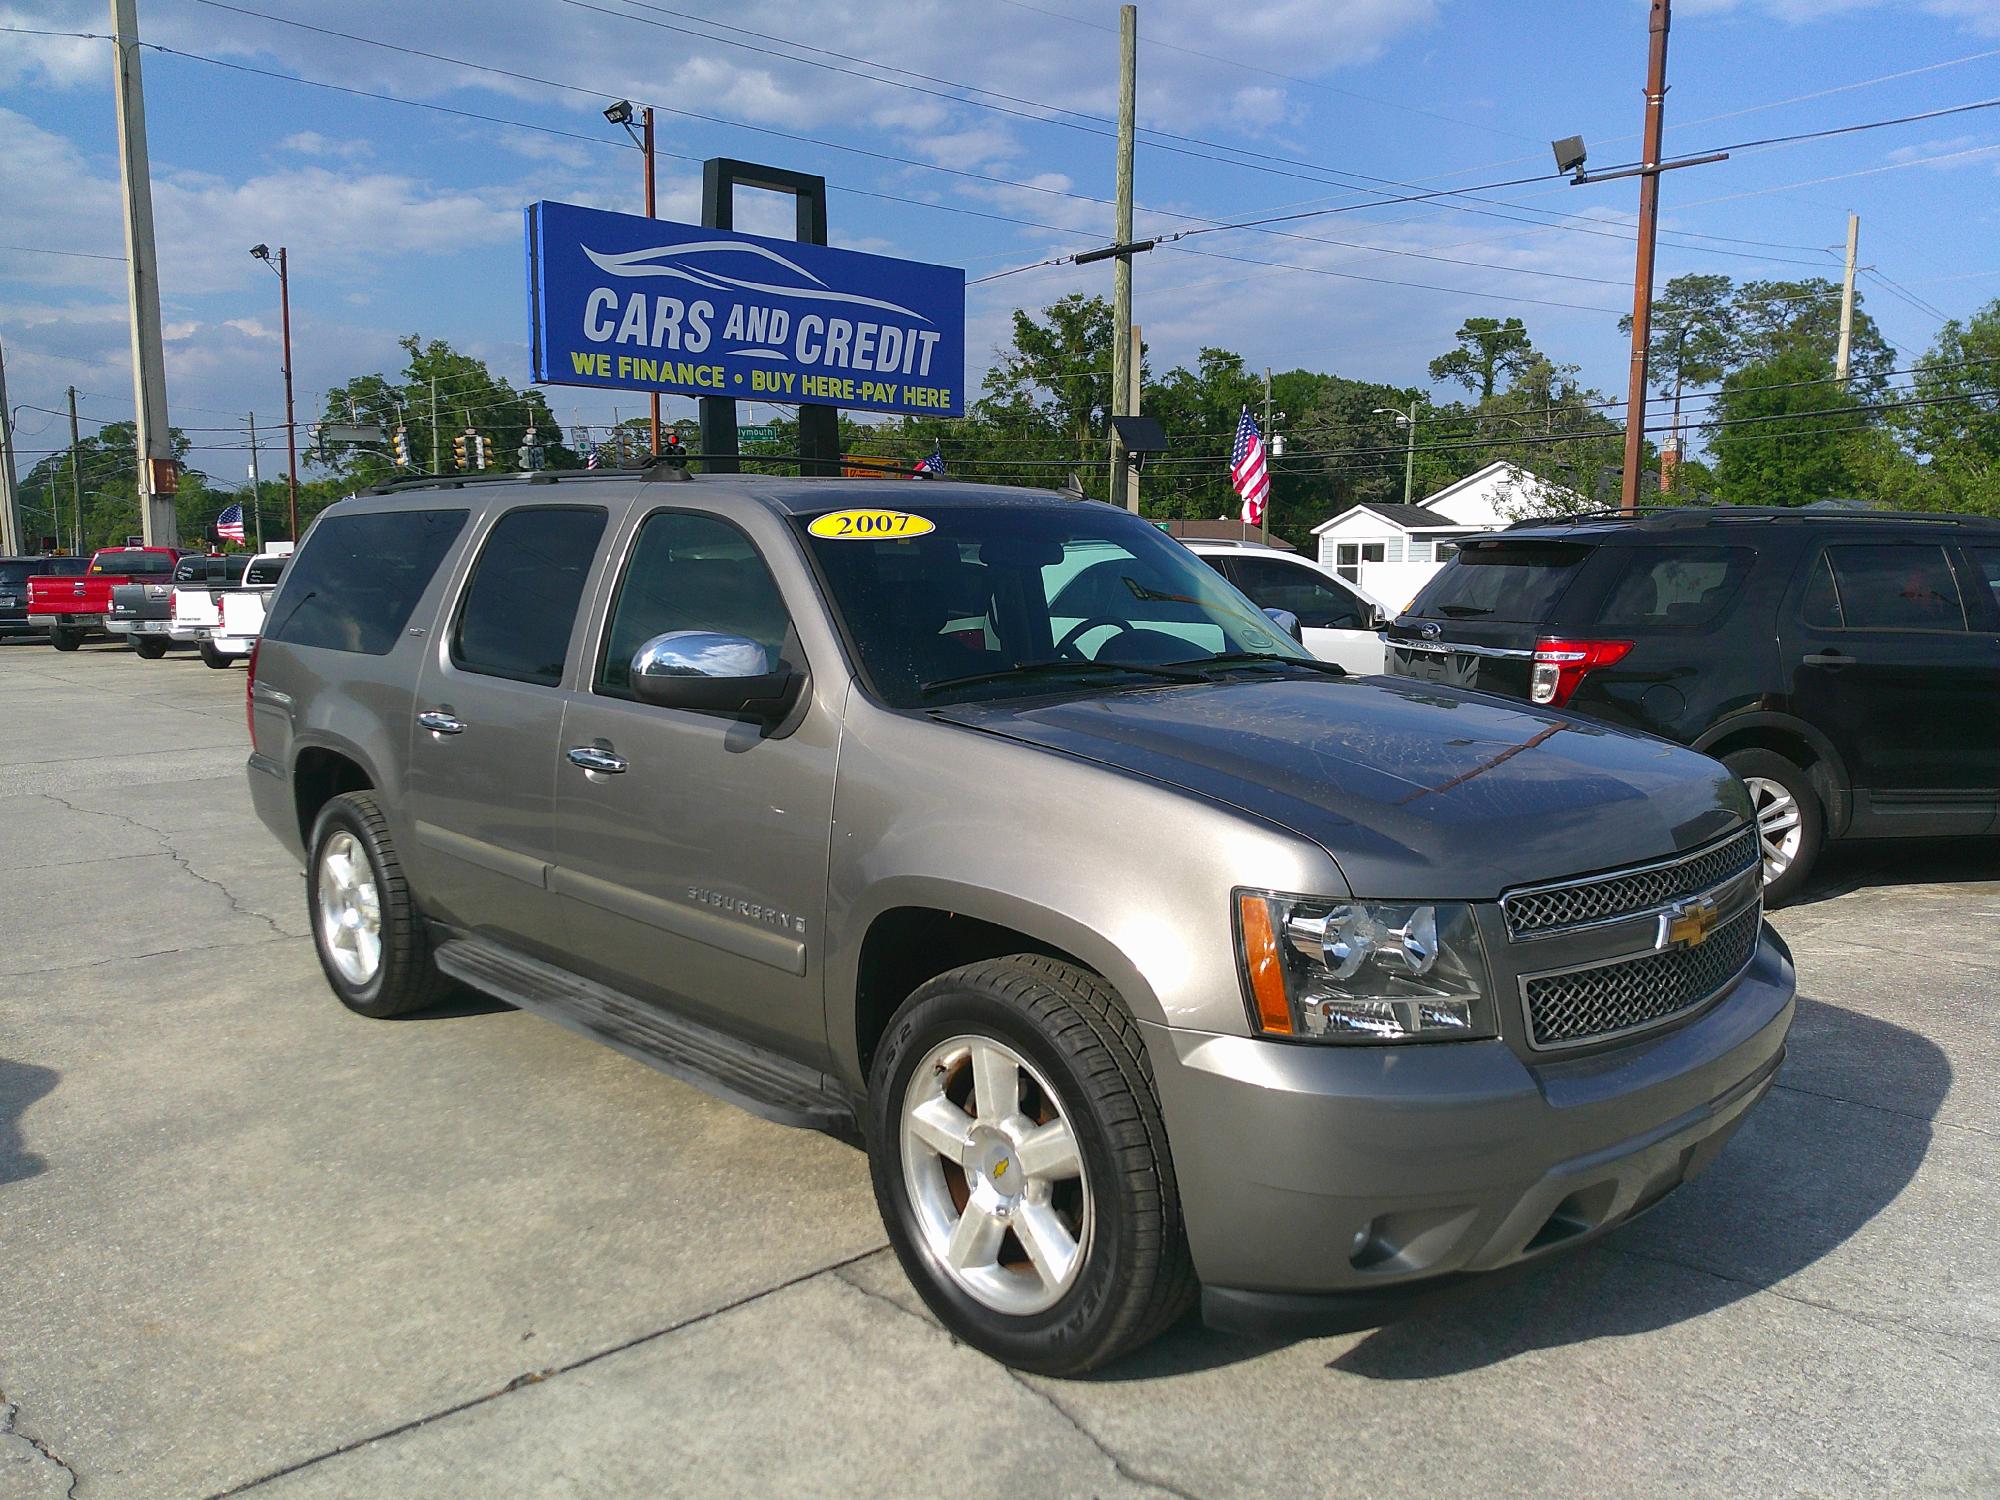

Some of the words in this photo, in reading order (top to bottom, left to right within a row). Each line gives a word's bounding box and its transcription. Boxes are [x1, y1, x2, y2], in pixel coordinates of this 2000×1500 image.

[583, 287, 715, 353] CARS
[723, 303, 790, 345] AND
[795, 314, 941, 377] CREDIT
[571, 351, 612, 377] WE
[618, 356, 725, 388] FINANCE
[752, 369, 796, 393] BUY
[903, 386, 951, 408] HERE
[737, 428, 773, 437] lymouth
[836, 515, 910, 536] 2007
[687, 885, 791, 928] SUBURBAN
